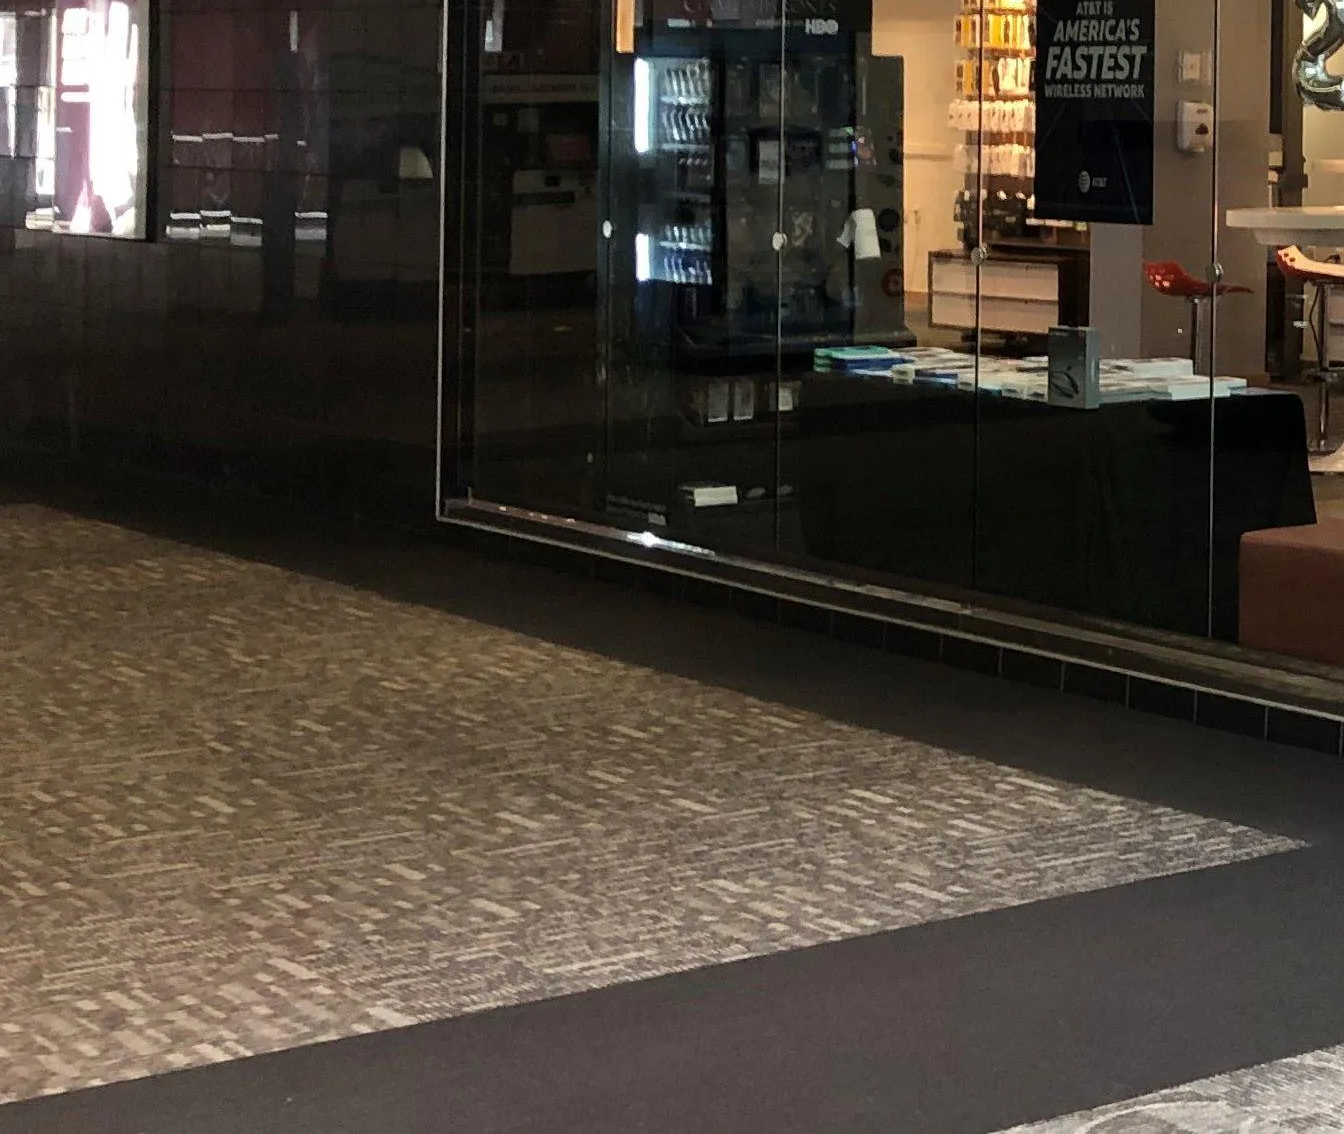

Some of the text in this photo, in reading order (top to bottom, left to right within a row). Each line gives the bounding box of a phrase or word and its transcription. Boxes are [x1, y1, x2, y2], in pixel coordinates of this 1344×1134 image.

[1076, 0, 1114, 15] AT&T IS
[805, 18, 839, 35] HBO
[1053, 18, 1141, 42] AMERICA'S
[1045, 45, 1148, 80] FASTEST
[1044, 84, 1145, 98] WIRELESS NETWORK
